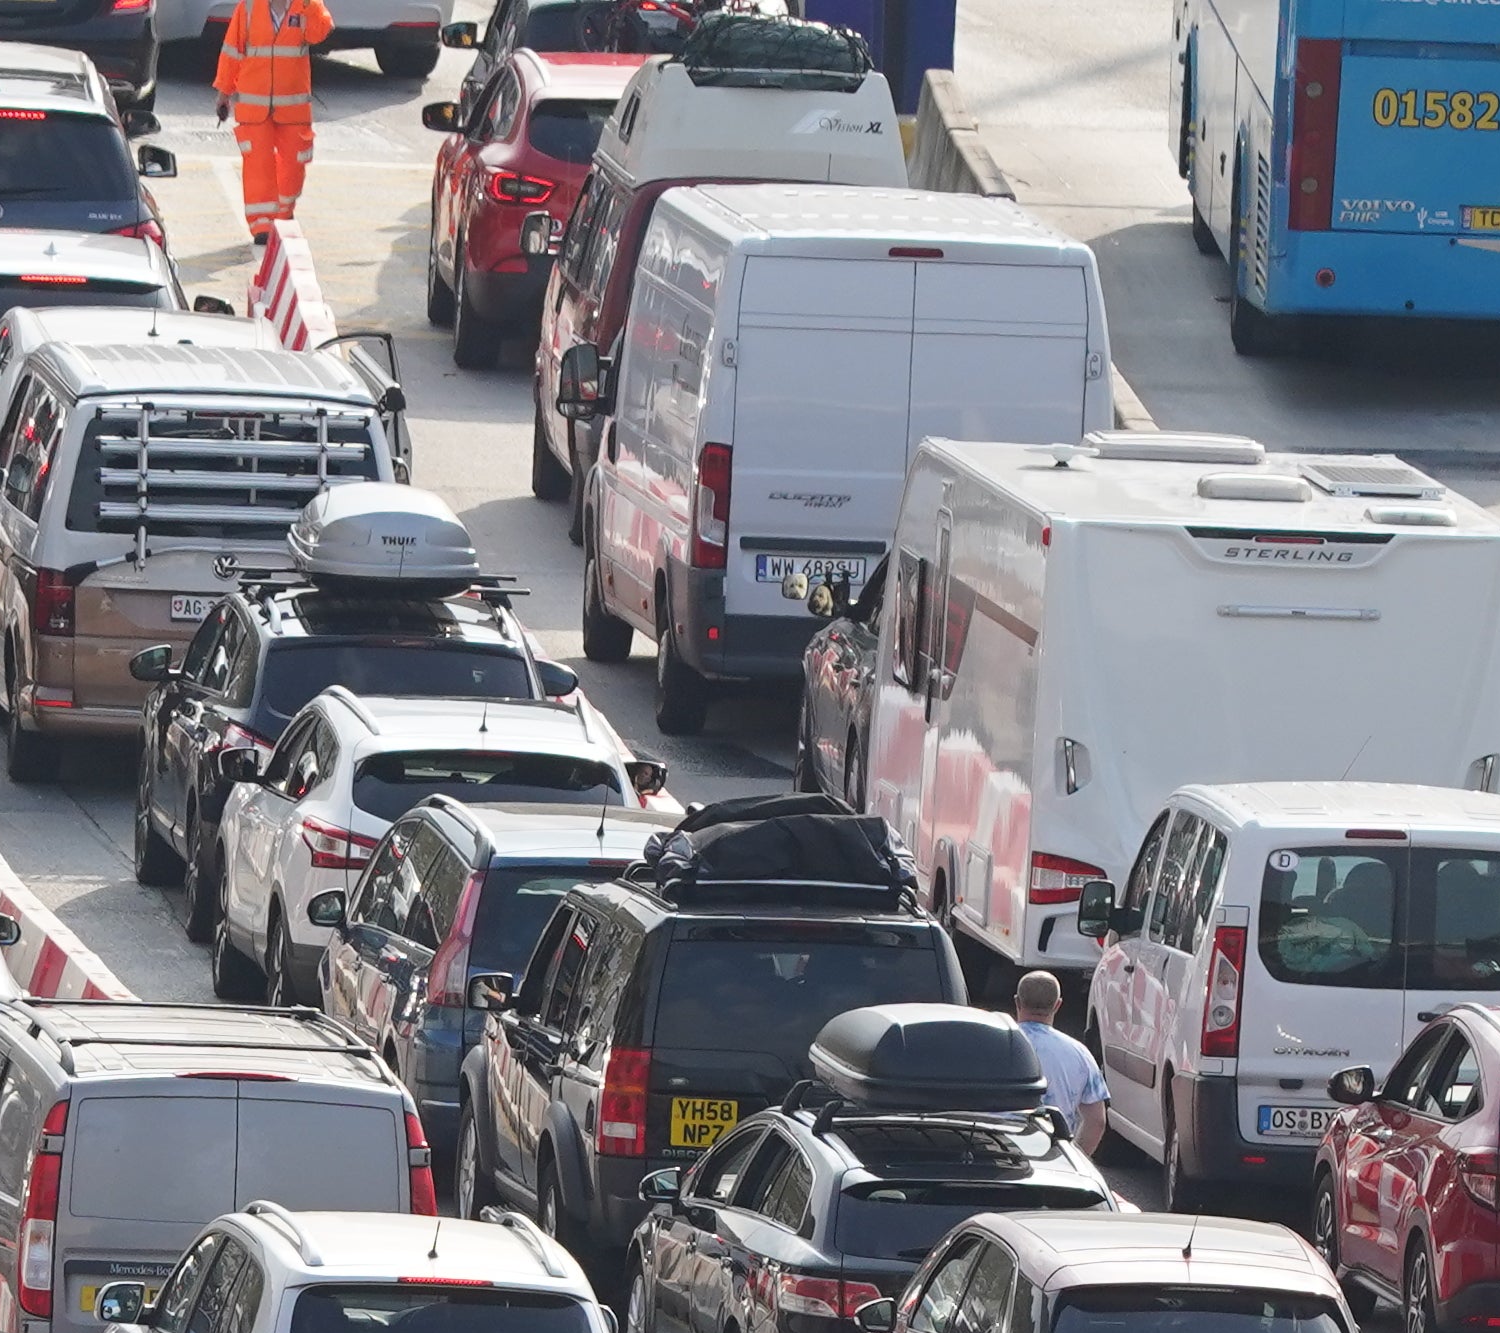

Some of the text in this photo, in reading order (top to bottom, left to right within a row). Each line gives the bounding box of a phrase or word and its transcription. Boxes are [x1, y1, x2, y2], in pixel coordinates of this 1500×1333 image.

[1372, 87, 1500, 131] 01582
[865, 121, 884, 135] XL
[1341, 199, 1415, 212] VOLVO
[1225, 547, 1353, 562] STERLING
[770, 558, 795, 576] WW
[1279, 853, 1291, 868] D
[677, 1100, 733, 1122] YH58
[1273, 1110, 1297, 1128] OS
